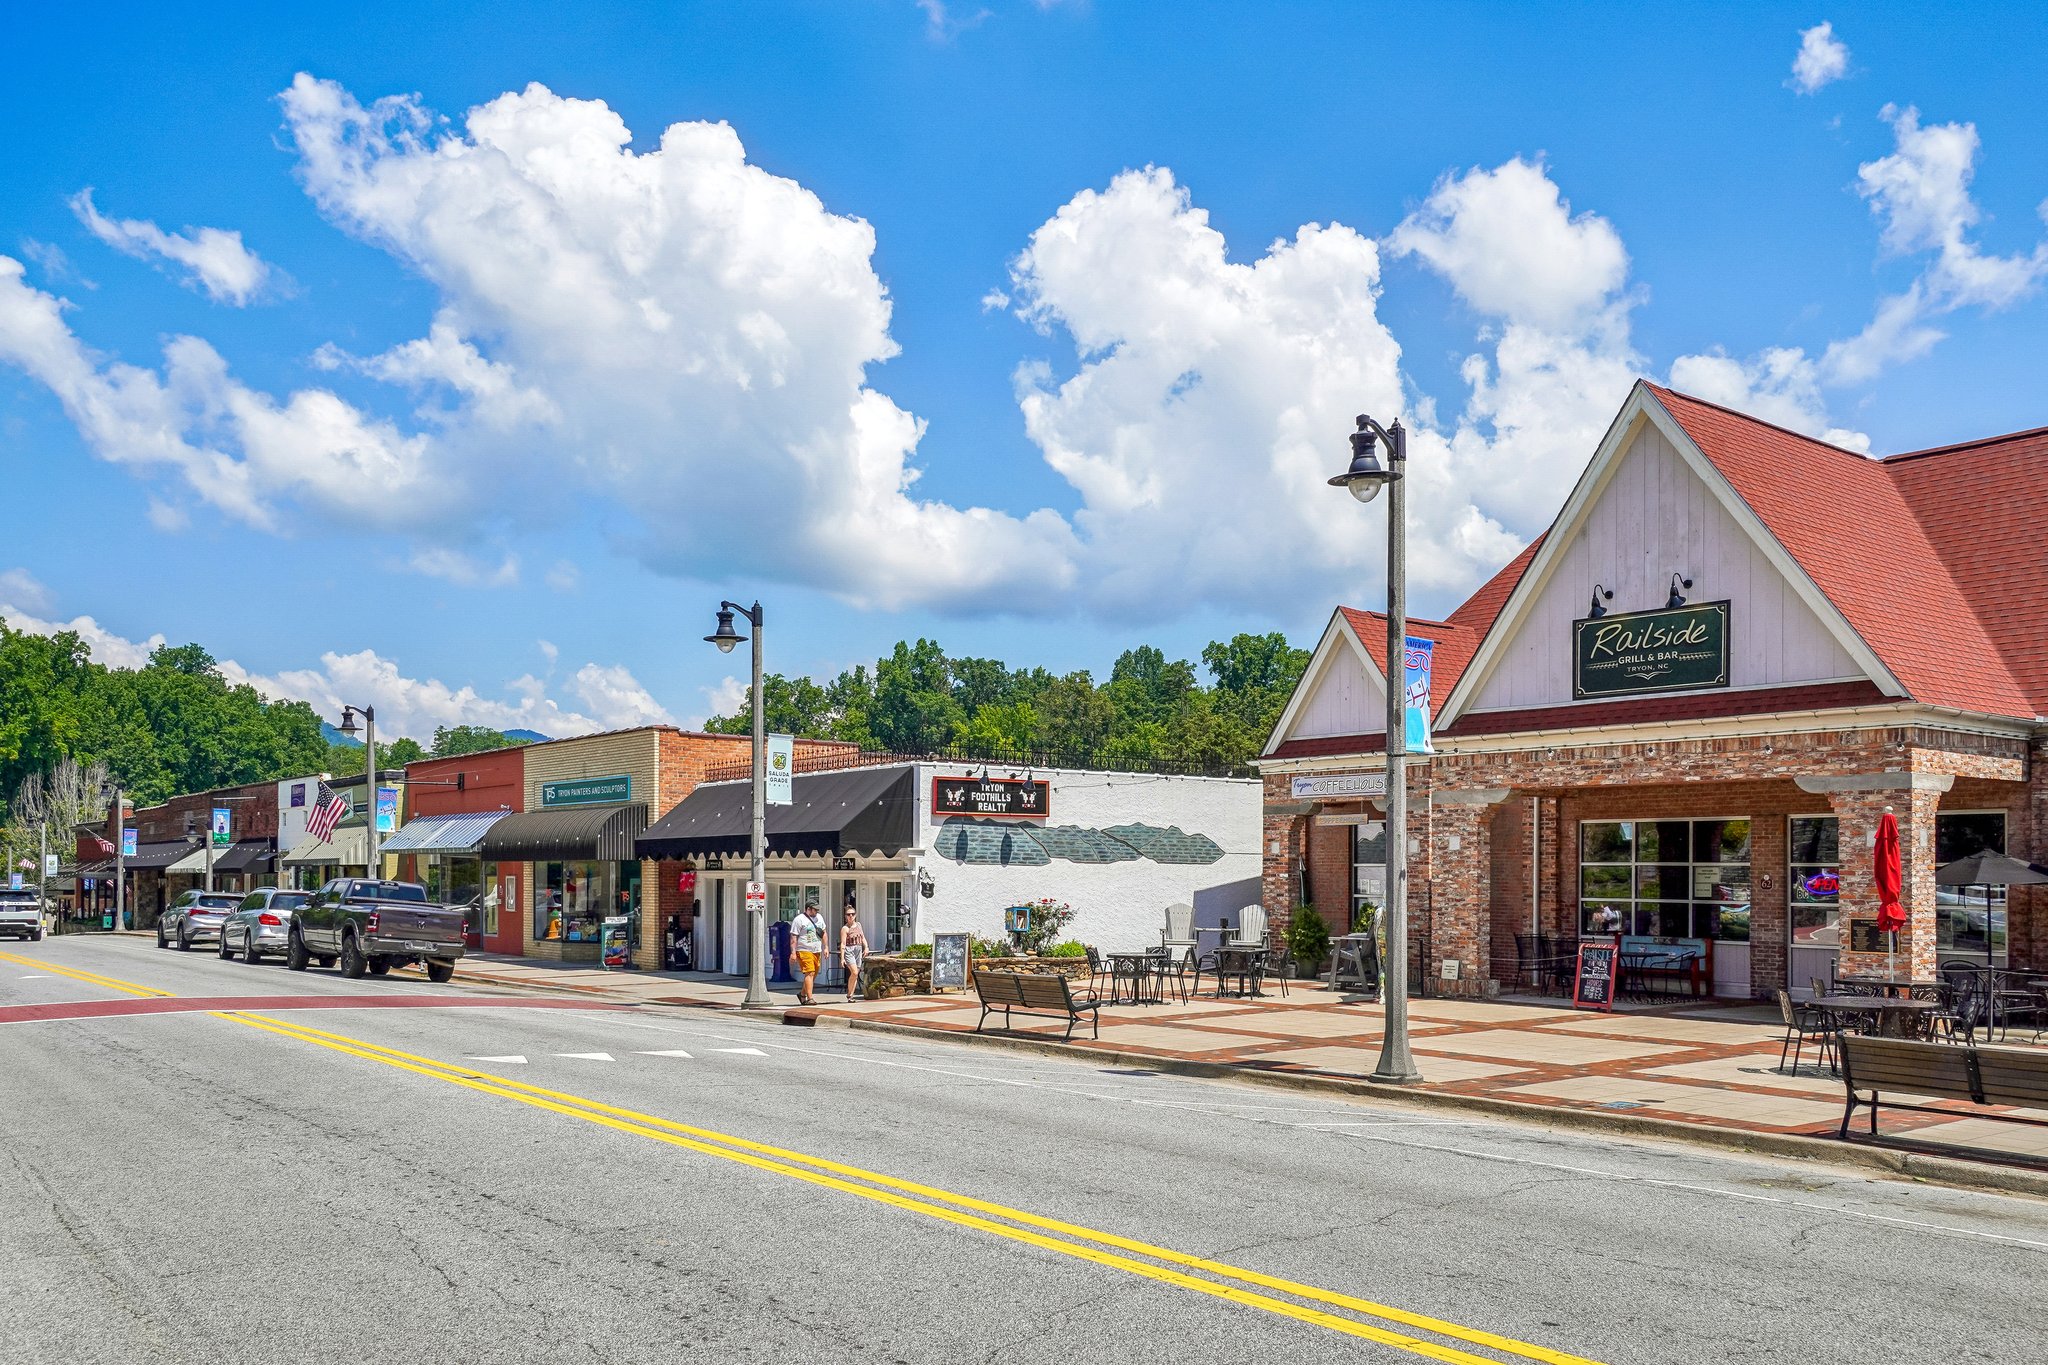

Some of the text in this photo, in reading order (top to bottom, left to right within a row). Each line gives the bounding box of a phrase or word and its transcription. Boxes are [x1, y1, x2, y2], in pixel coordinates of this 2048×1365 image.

[1590, 618, 1709, 660] Railside
[1618, 651, 1678, 665] GRILL & BAR
[1627, 664, 1656, 673] TRYON,
[557, 789, 571, 797] TRYON
[571, 787, 591, 796] PAINTERS
[591, 786, 600, 795] AND
[601, 784, 626, 794] SCULPTORS
[981, 783, 1004, 792] TRYON
[1293, 778, 1312, 794] Tryon
[971, 792, 1012, 802] FOOTHILLS
[978, 802, 1007, 812] REALTY
[1761, 880, 1771, 888] 62
